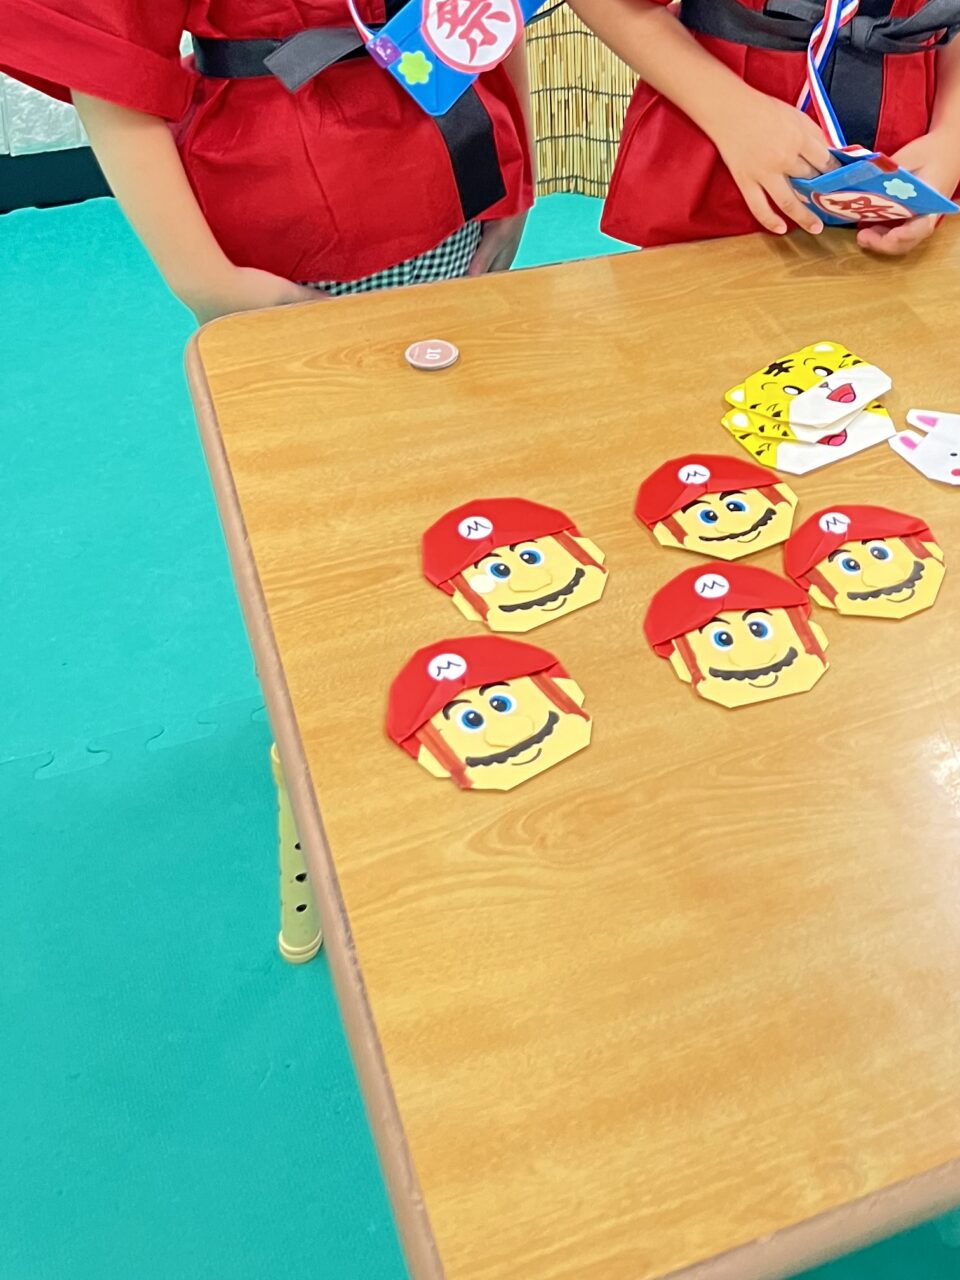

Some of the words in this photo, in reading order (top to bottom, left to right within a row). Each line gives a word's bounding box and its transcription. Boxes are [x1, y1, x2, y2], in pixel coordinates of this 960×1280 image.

[425, 348, 442, 360] 10
[685, 469, 707, 482] M
[466, 520, 491, 537] M
[825, 516, 847, 531] M
[700, 580, 725, 593] M
[436, 659, 462, 677] M
